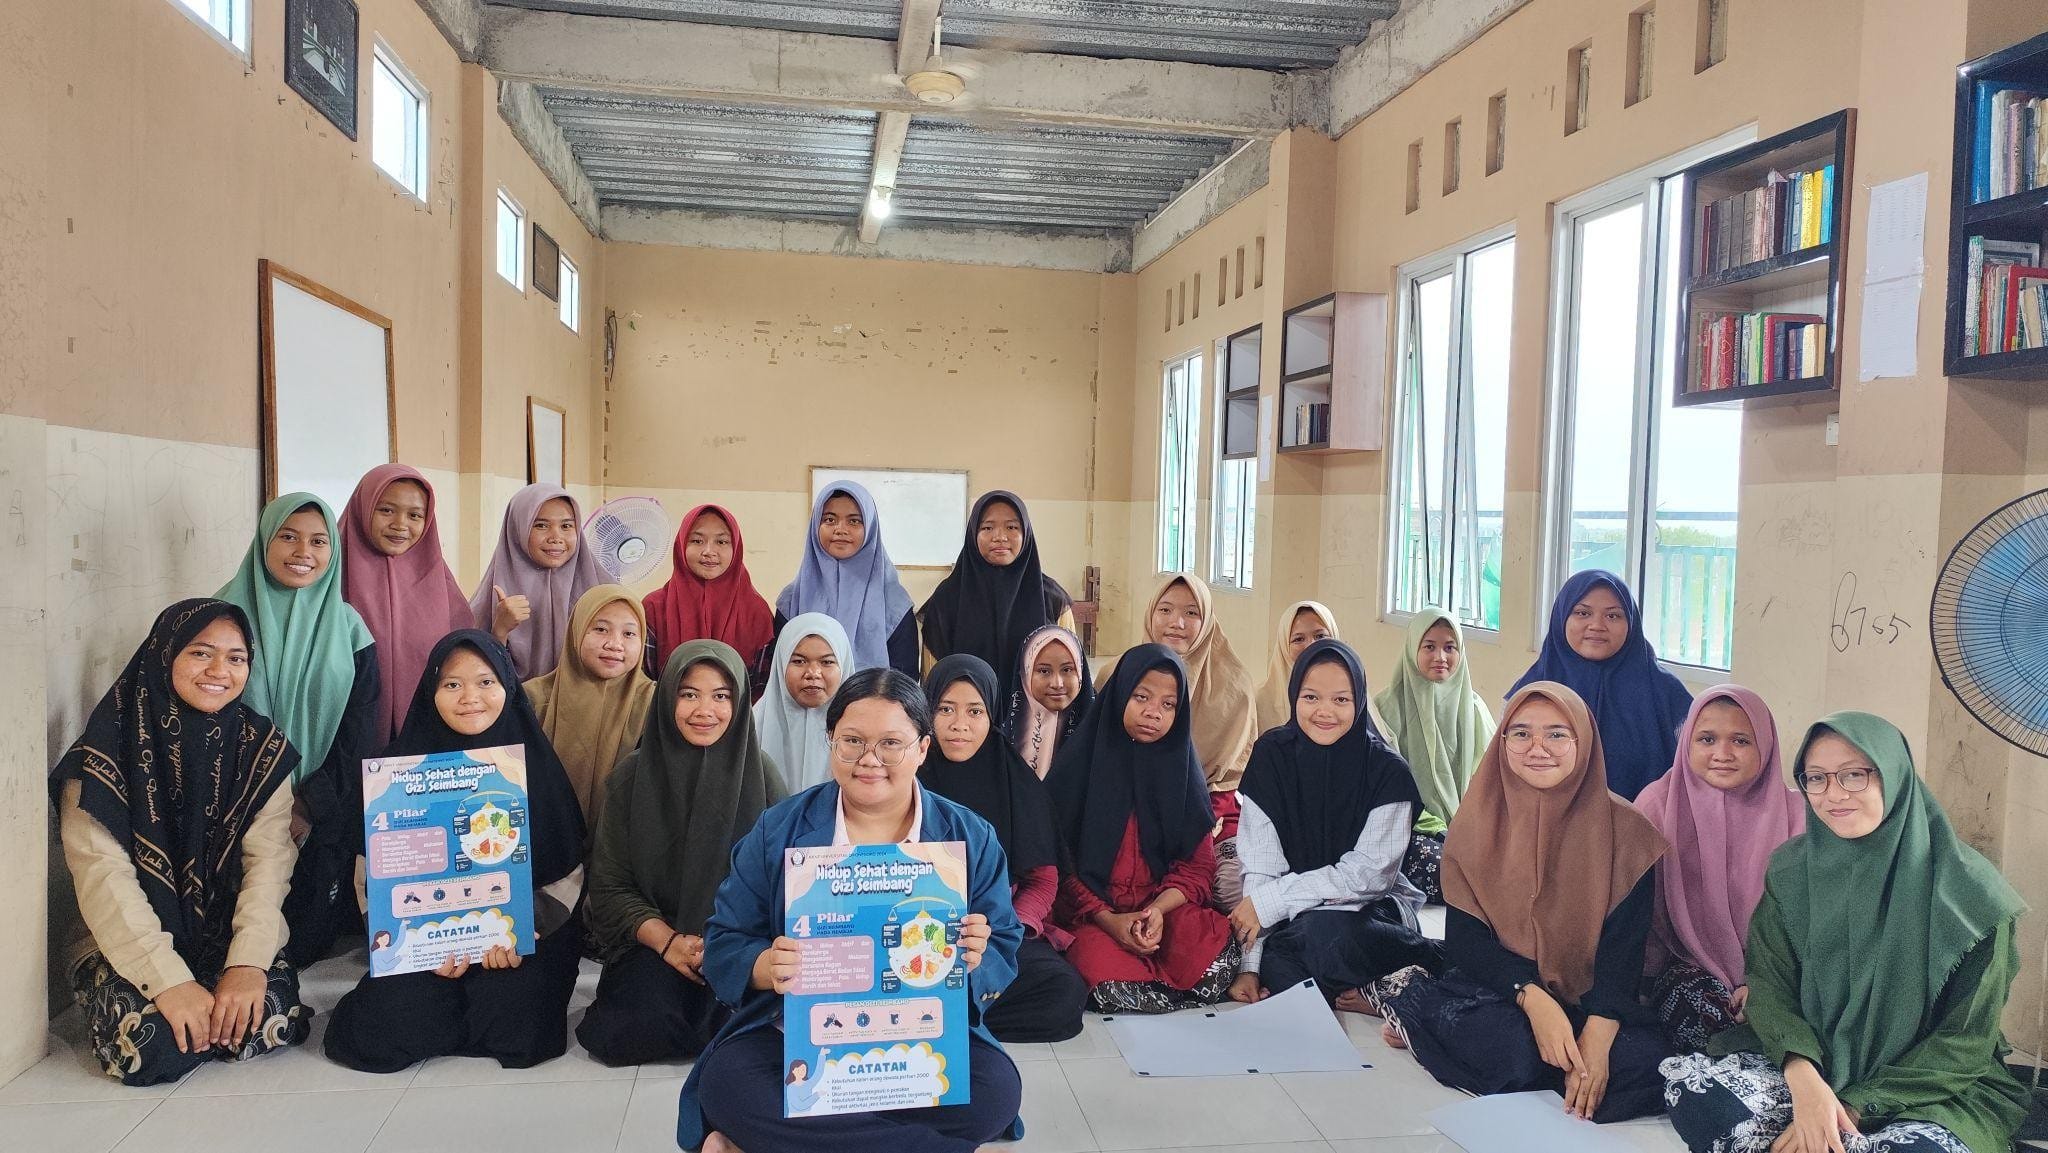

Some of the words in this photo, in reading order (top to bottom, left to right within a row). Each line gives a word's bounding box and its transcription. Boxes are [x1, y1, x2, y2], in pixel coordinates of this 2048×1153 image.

[391, 770, 423, 784] Hidup
[425, 766, 455, 781] Sehat
[457, 763, 496, 779] dengan
[405, 780, 426, 796] Gizi
[428, 777, 479, 794] Seimbang
[371, 812, 389, 831] 4
[393, 808, 428, 819] Pilar
[816, 863, 852, 882] Hidup
[854, 861, 889, 879] Sehat
[890, 859, 934, 880] dengan
[831, 879, 854, 896] Gizi
[857, 877, 914, 896] Seimbang
[792, 914, 812, 938] 4
[816, 912, 855, 924] Pilar
[427, 925, 480, 939] CATATAN
[848, 1061, 908, 1075] CATATAN
